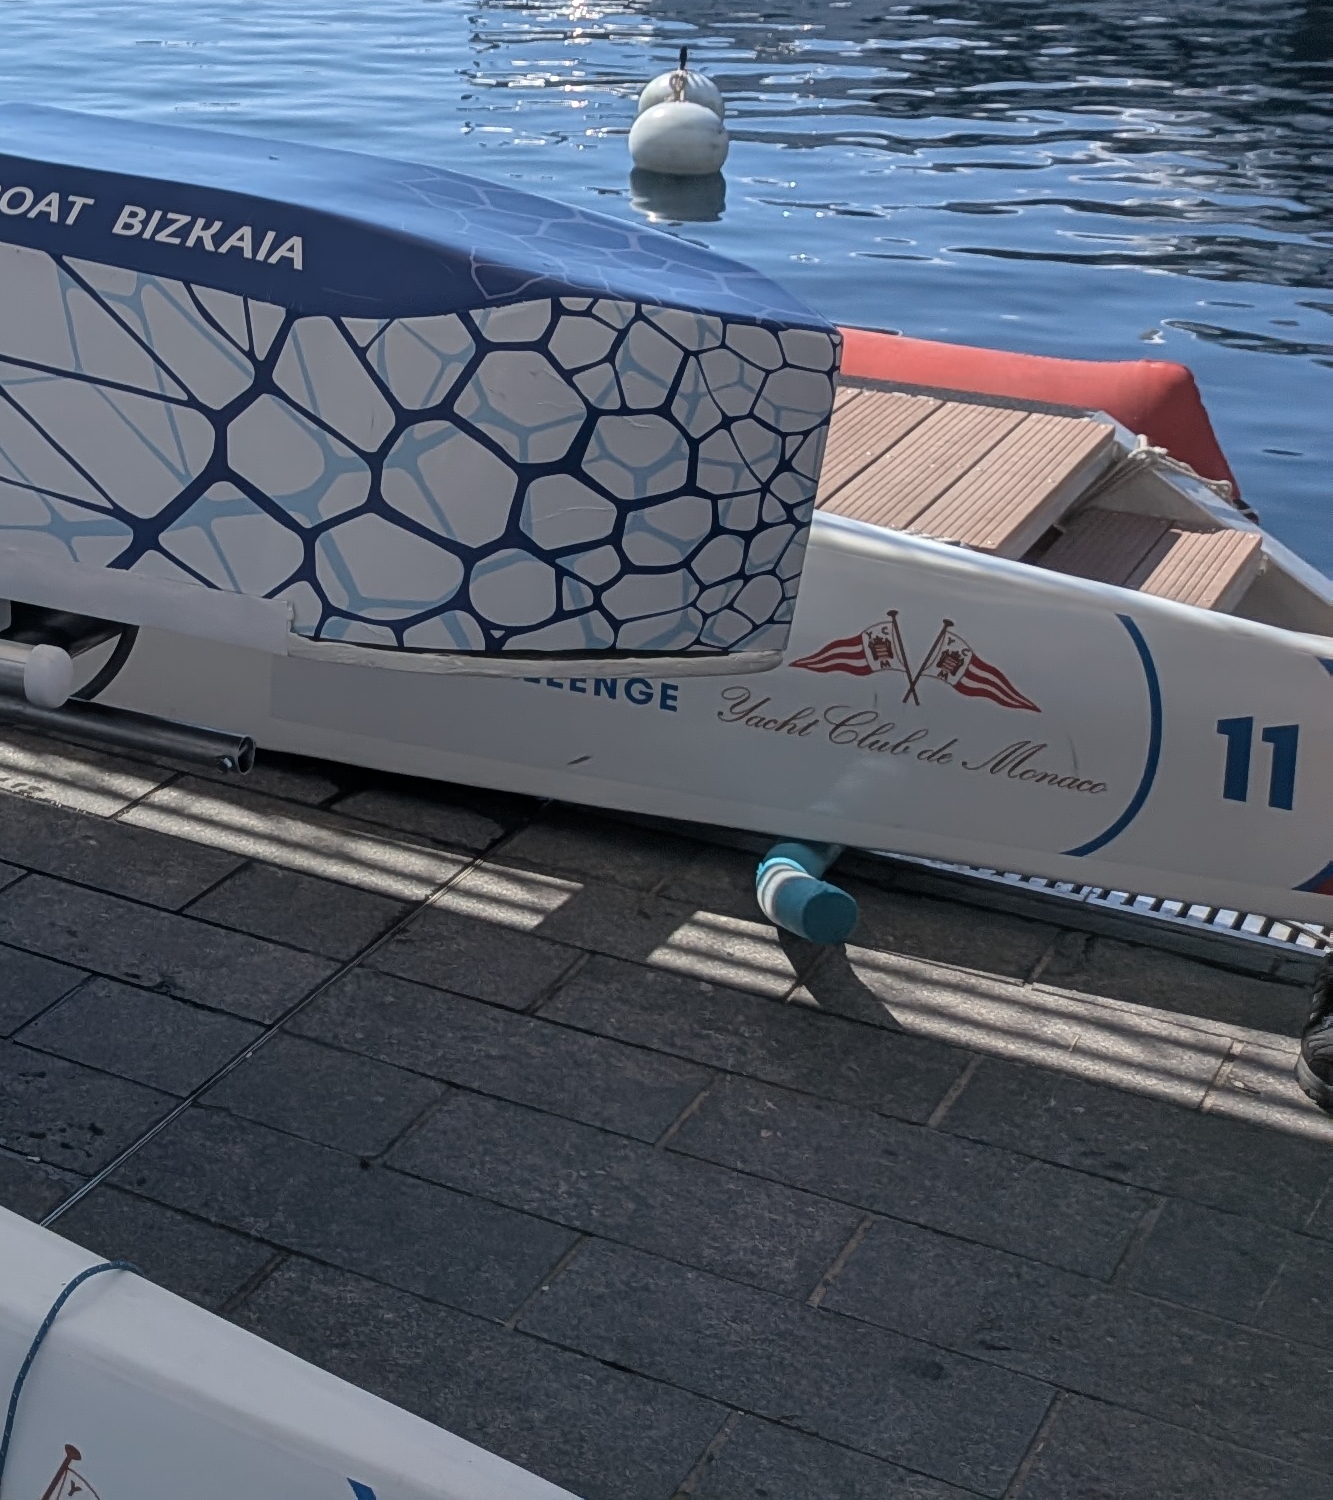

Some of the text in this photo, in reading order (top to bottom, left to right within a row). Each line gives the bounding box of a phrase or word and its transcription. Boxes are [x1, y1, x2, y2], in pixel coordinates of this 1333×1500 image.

[111, 203, 305, 271] BIZKAIA
[717, 686, 1108, 795] Yacht Club de Monaco
[1216, 716, 1300, 811] 11
